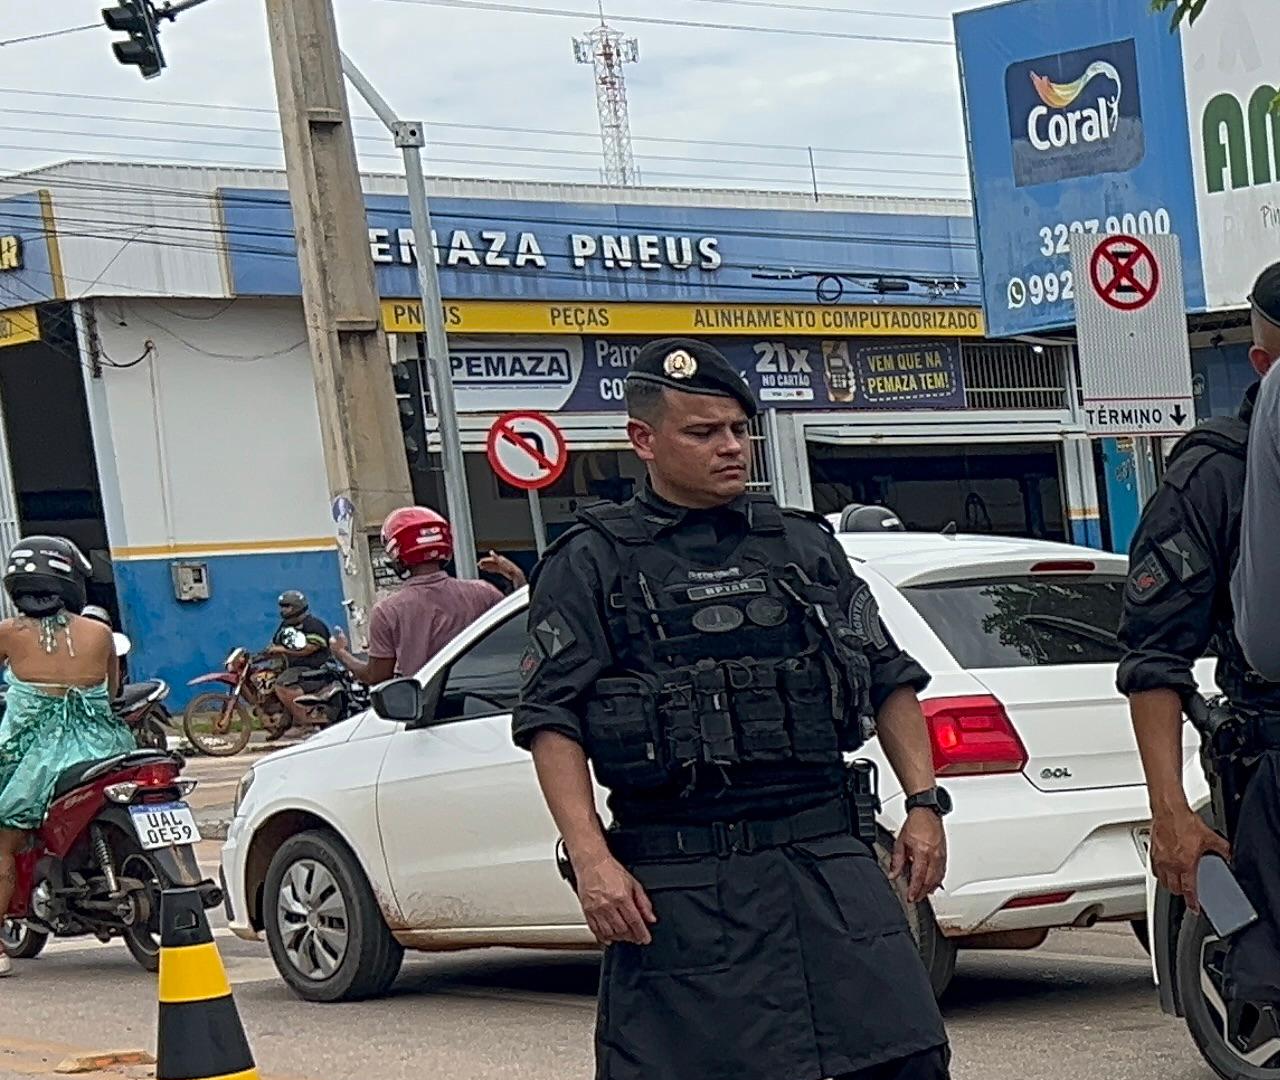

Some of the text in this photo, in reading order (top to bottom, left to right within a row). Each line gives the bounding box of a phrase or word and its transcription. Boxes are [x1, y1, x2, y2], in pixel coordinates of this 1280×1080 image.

[1028, 97, 1110, 150] Coral
[571, 233, 723, 270] PNEUS
[550, 307, 610, 331] PEÇAS
[693, 309, 816, 329] ALINHAMENTO
[822, 310, 979, 330] COMPUTADORIZADO
[450, 355, 566, 378] PEMAZA
[867, 350, 943, 372] VEM QUE NA
[762, 374, 776, 386] NO
[777, 372, 811, 386] CARTÃO
[867, 371, 950, 394] PEMAZA TEM!
[1085, 405, 1163, 425] TÉRMINO
[147, 811, 183, 828] UAL
